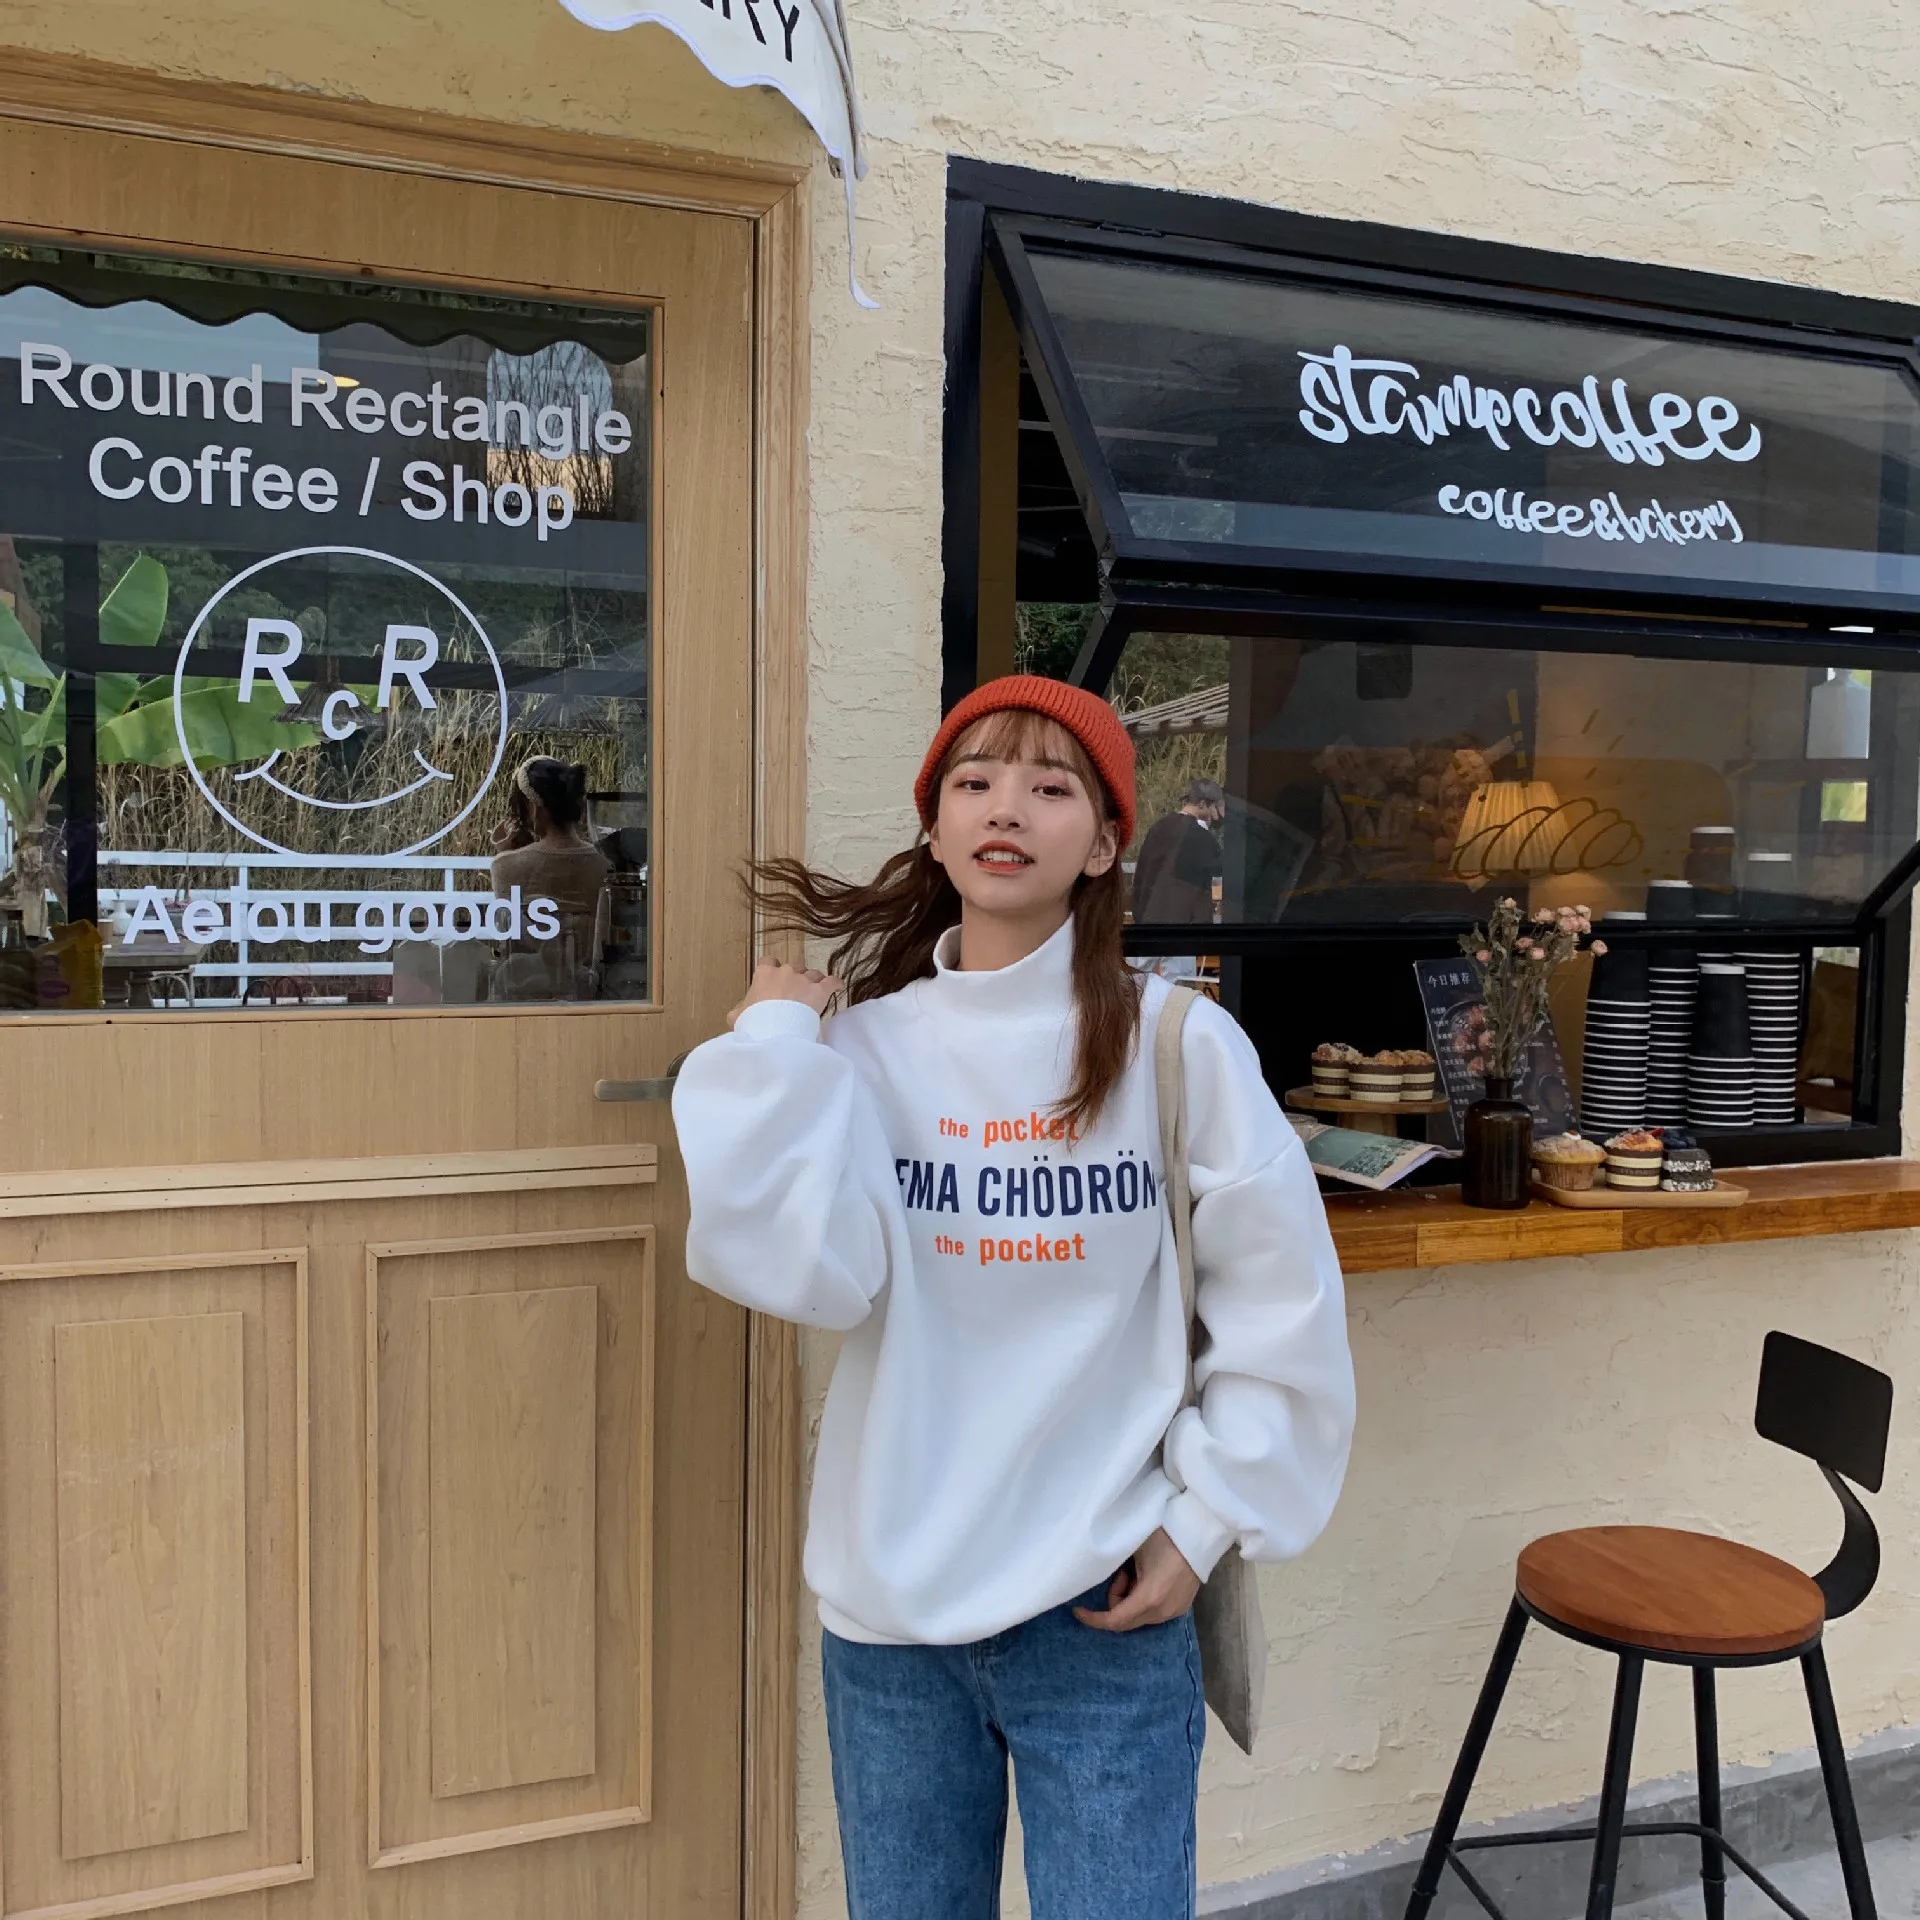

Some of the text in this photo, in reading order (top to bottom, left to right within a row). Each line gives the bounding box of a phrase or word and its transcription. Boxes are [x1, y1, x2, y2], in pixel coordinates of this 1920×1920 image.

[19, 341, 633, 461] Round Rectangle
[88, 437, 575, 542] Coffee / Shop
[355, 885, 562, 954] goods
[1428, 971, 1470, 989] 今日推荐
[939, 1117, 969, 1139] the
[977, 1150, 1157, 1218] CHÖDRÖN
[935, 1233, 1086, 1266] the pocket
